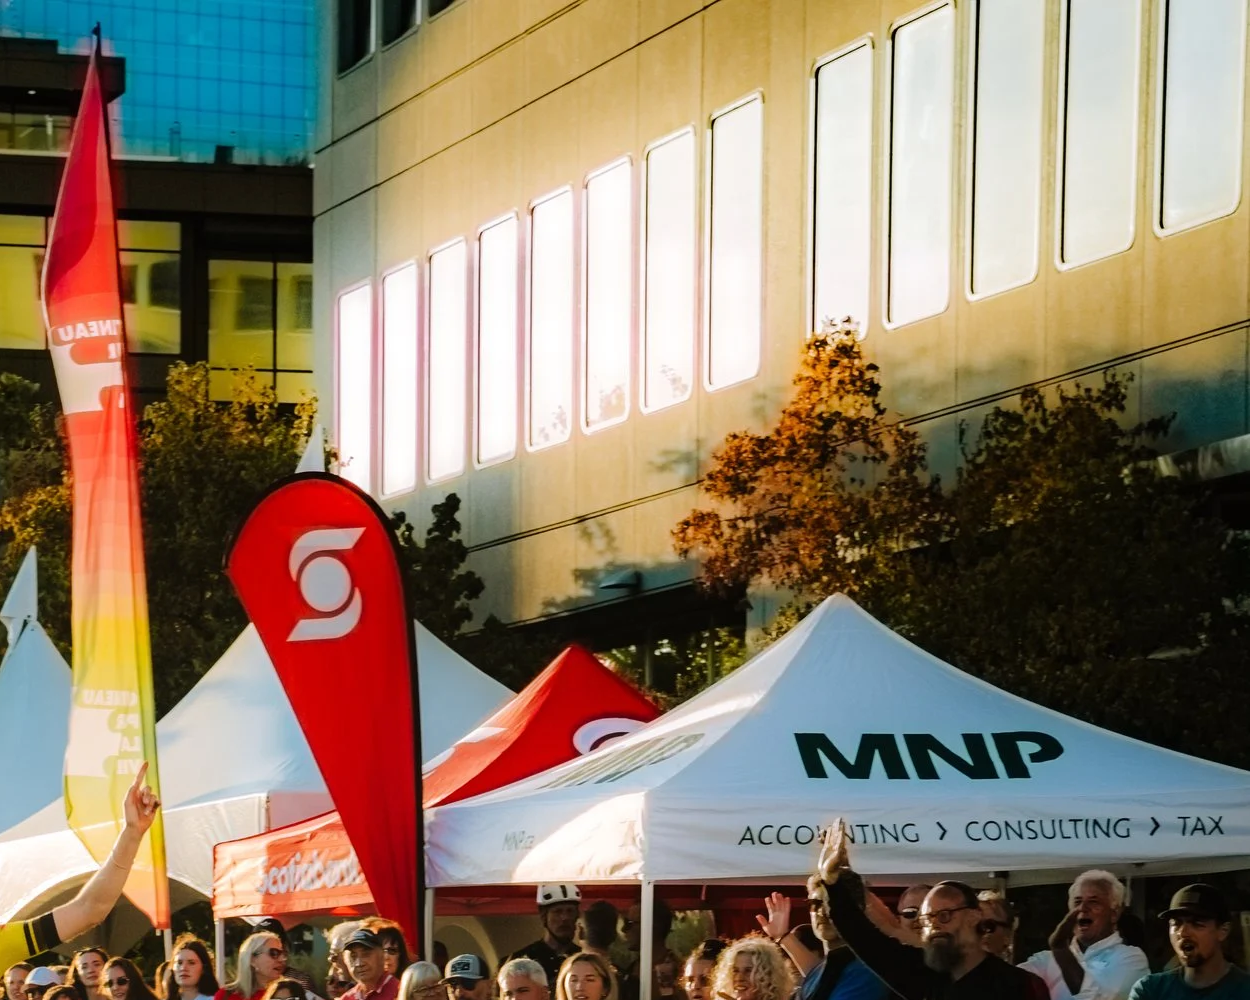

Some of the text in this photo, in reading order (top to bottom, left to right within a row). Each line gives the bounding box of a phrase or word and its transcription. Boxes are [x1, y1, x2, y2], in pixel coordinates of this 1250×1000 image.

[793, 731, 1065, 780] MNP
[965, 817, 1131, 842] CONSULTING
[1177, 815, 1225, 837] TAX
